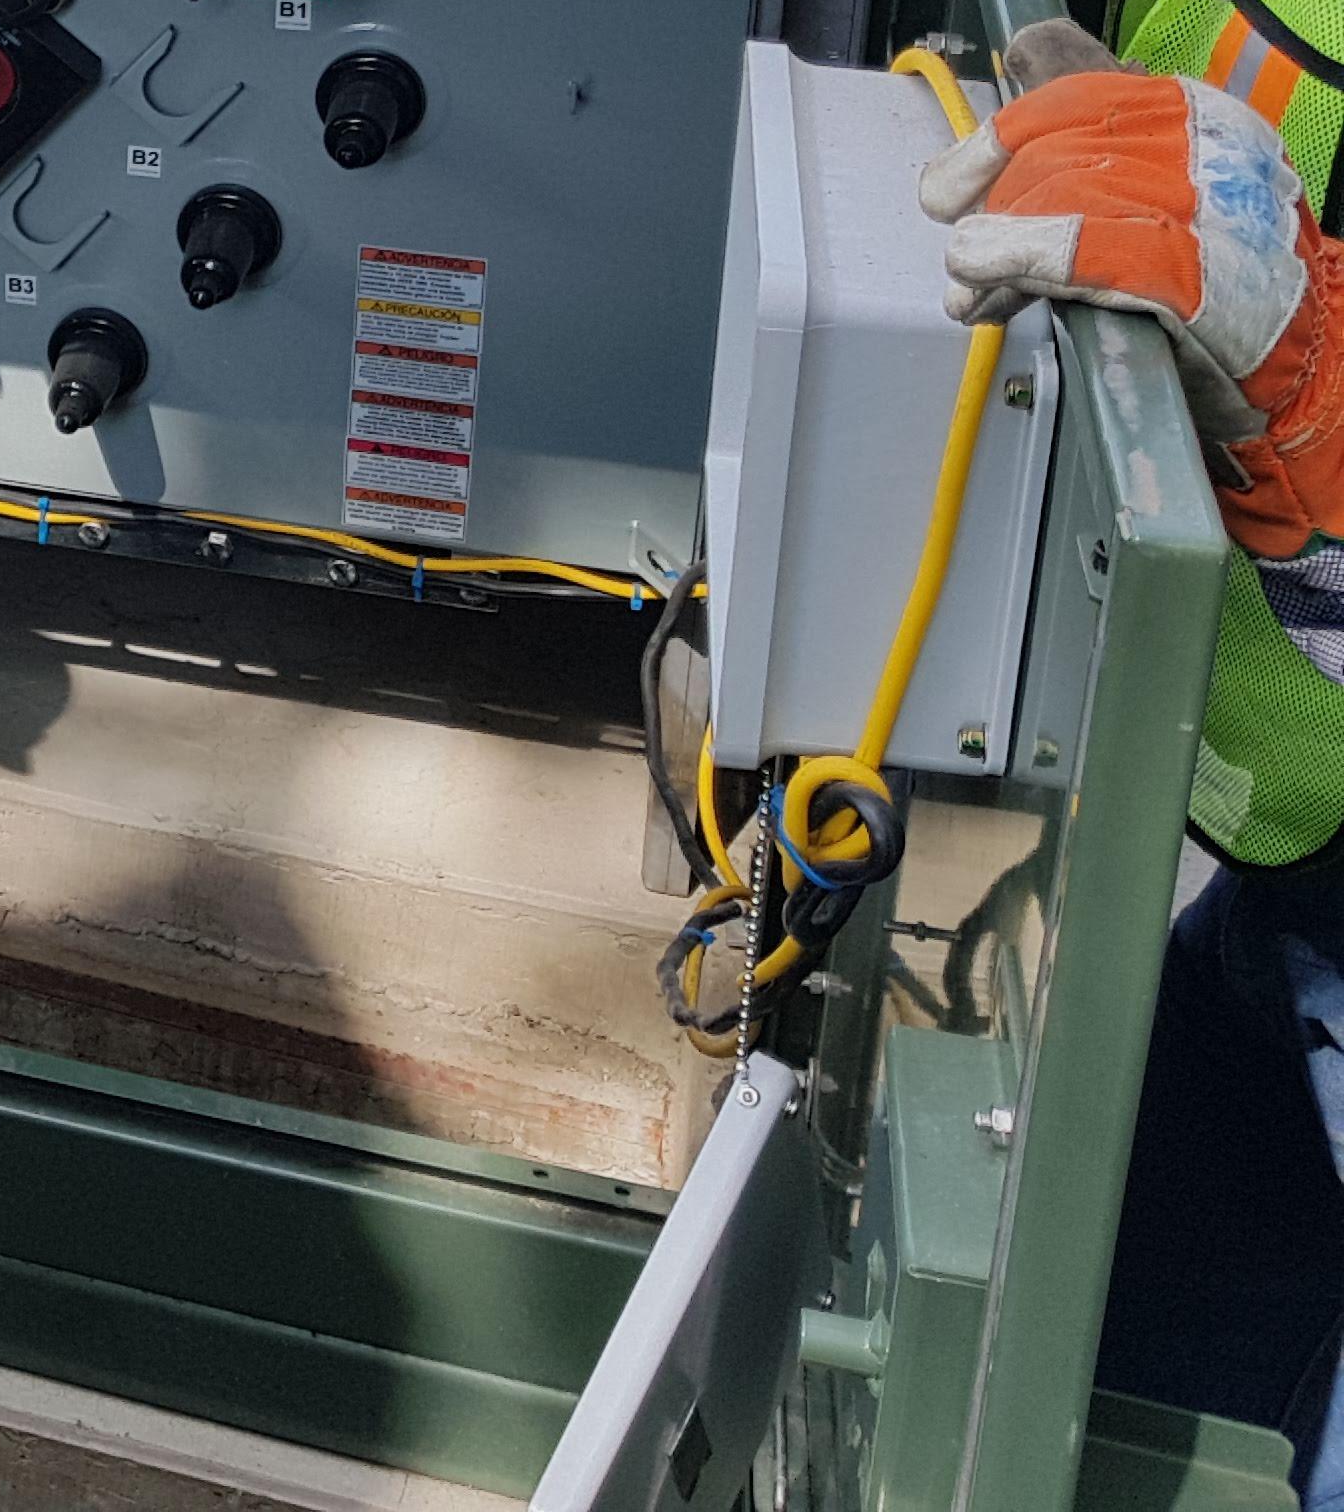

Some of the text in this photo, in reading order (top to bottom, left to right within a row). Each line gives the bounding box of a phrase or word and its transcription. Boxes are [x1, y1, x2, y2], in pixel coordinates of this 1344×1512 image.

[278, 1, 305, 19] B1
[132, 149, 158, 167] B2
[6, 277, 31, 294] B3
[385, 302, 461, 323] PRECAUCIÓN
